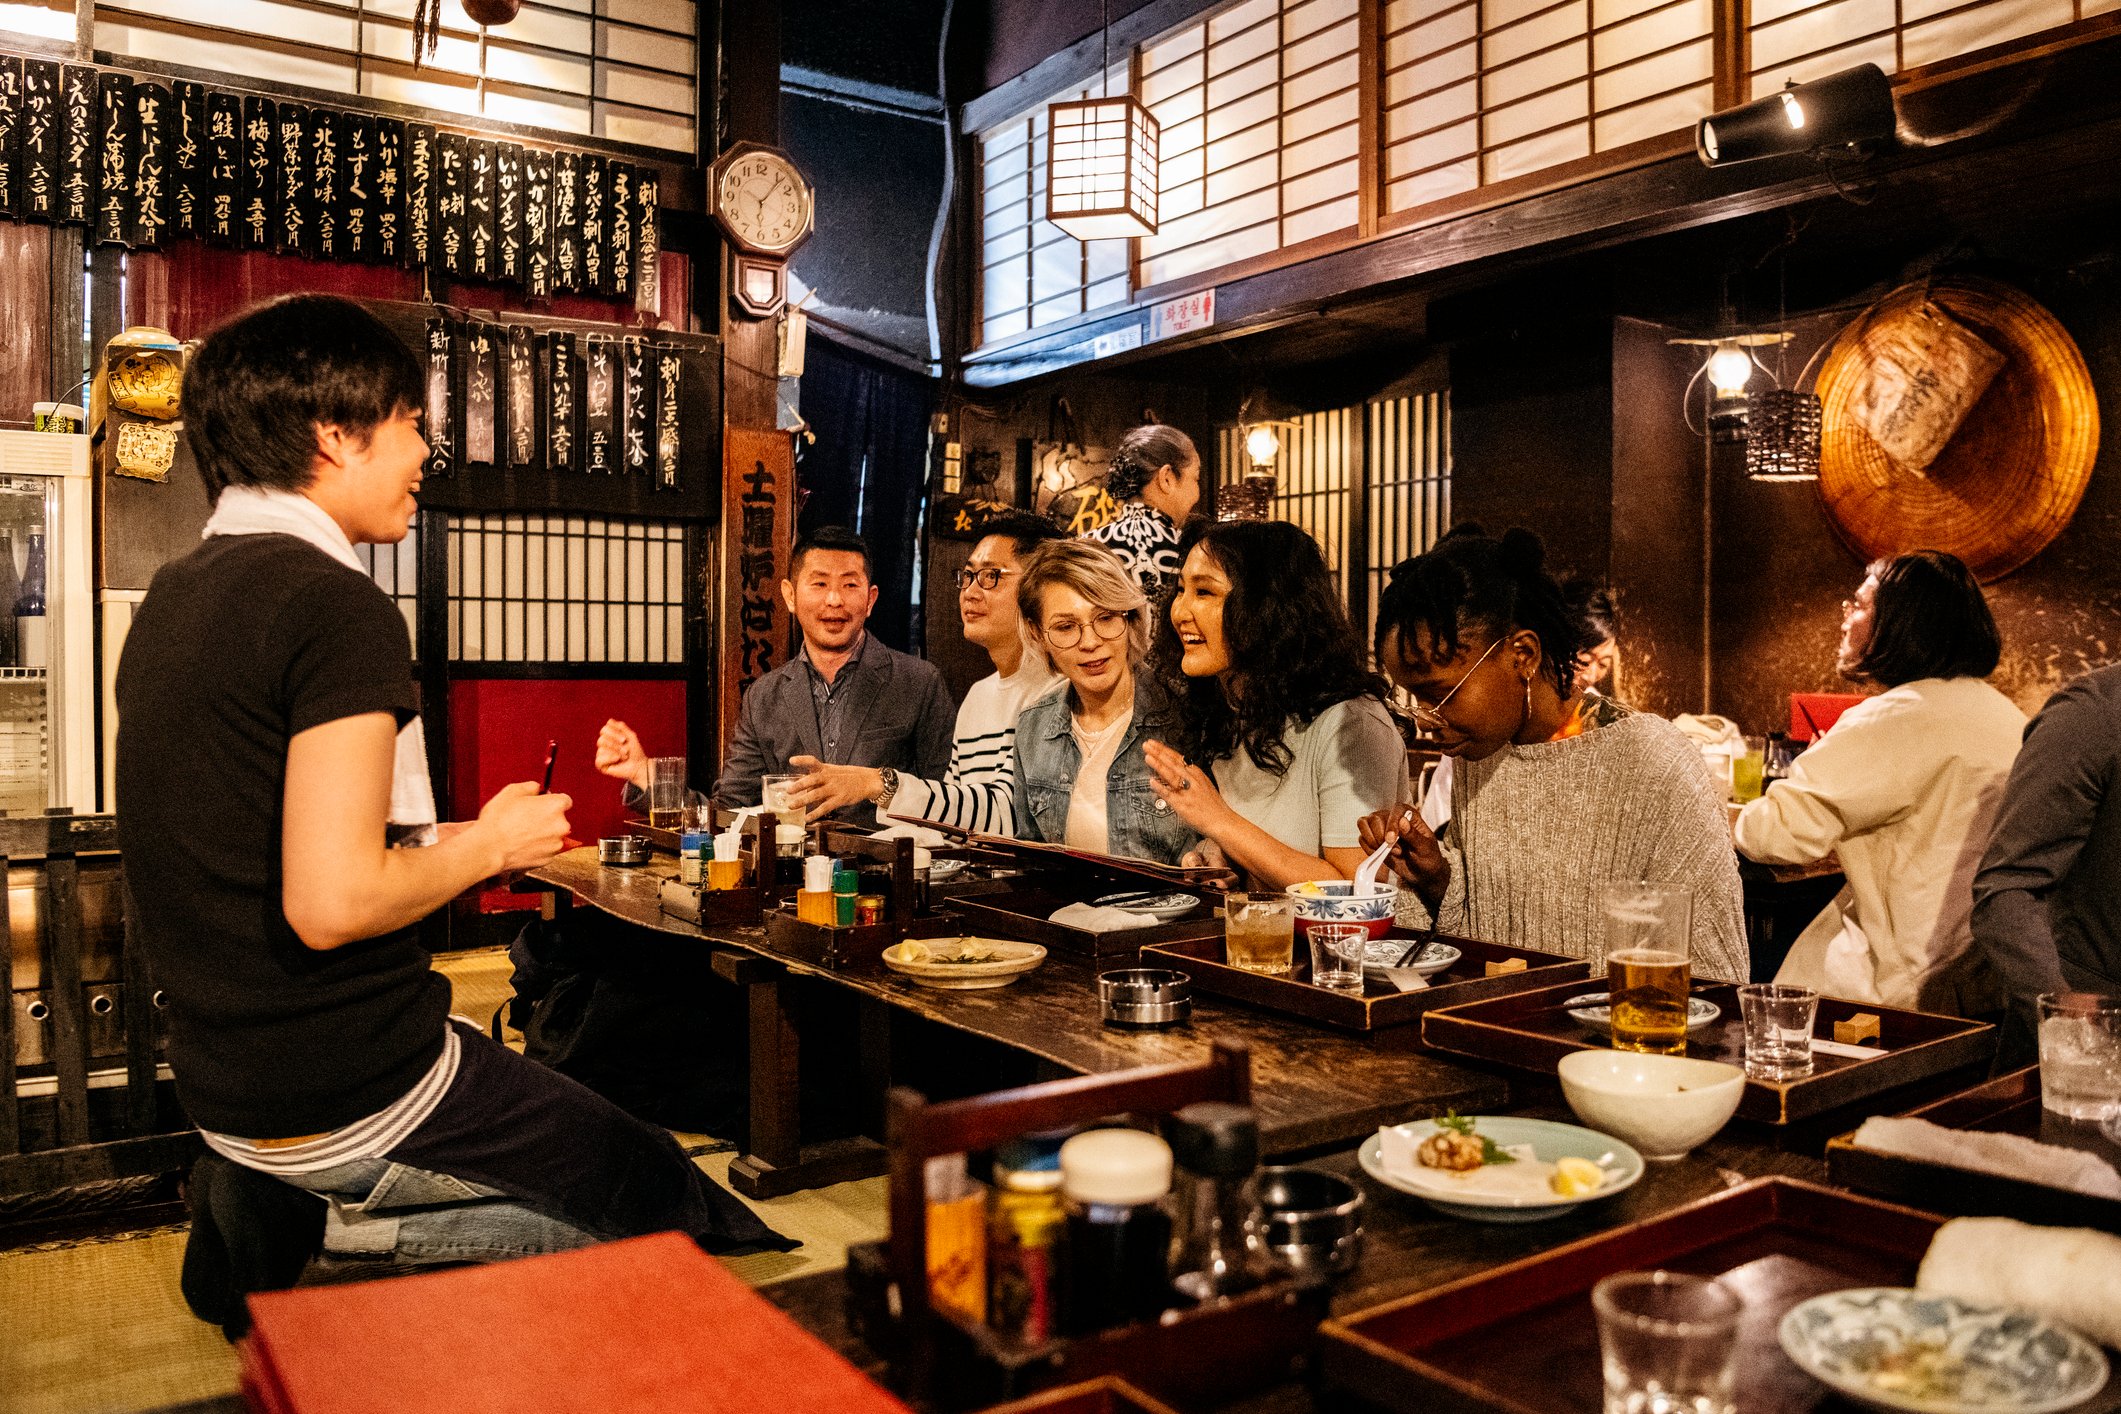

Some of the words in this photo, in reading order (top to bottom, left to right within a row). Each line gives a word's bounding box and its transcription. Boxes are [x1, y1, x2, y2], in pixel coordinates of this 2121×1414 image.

[742, 166, 751, 178] 11
[756, 163, 768, 176] 12
[729, 175, 741, 188] 10
[783, 184, 792, 196] 2
[726, 191, 735, 202] 9
[787, 202, 795, 213] 3
[730, 208, 739, 221] 8
[741, 223, 750, 234] 7
[783, 220, 791, 229] 4
[756, 230, 765, 241] 6
[771, 228, 780, 239] 5
[1165, 297, 1200, 322] 화장실
[1172, 319, 1191, 332] TOILET
